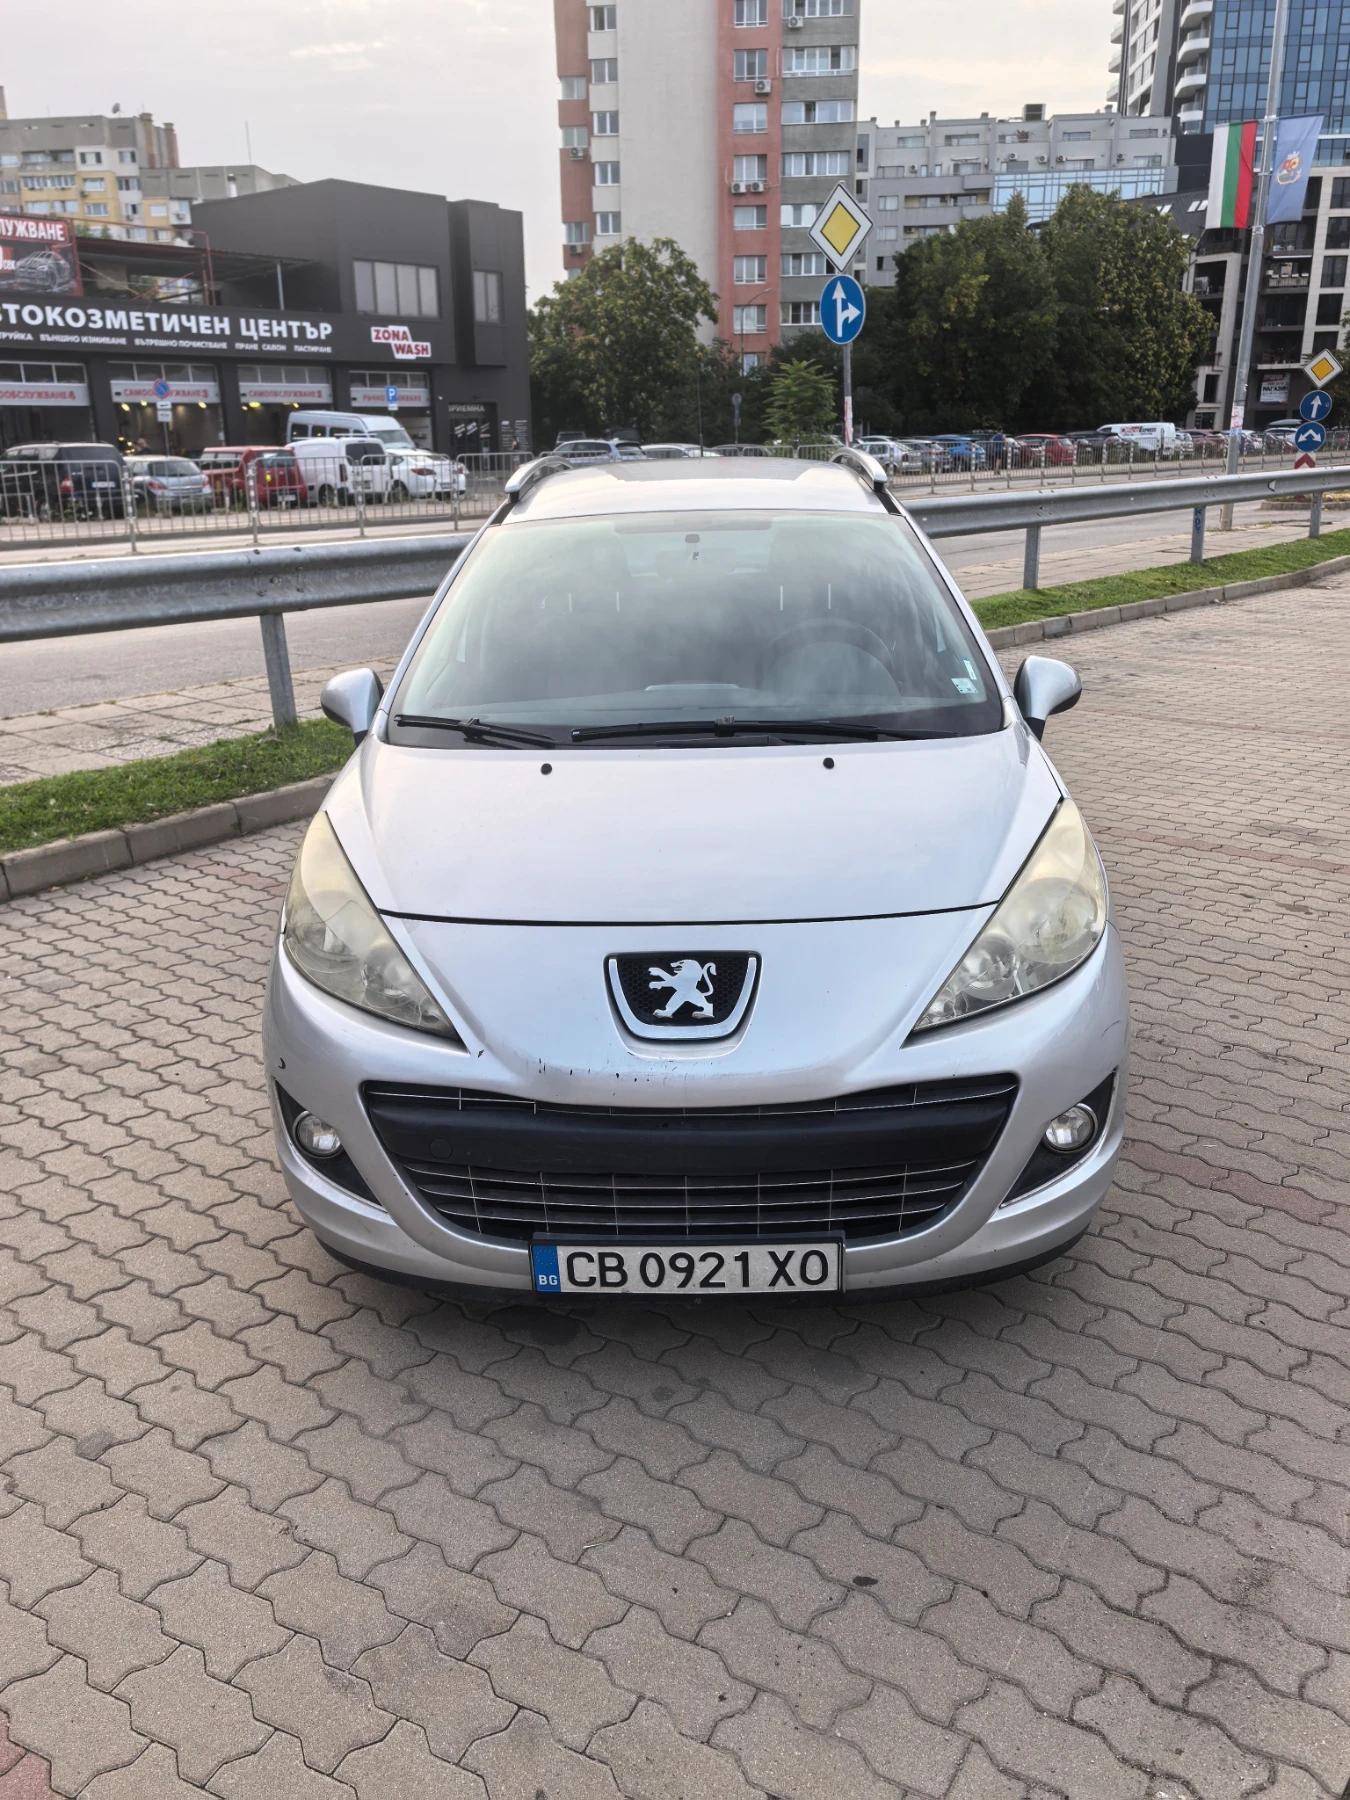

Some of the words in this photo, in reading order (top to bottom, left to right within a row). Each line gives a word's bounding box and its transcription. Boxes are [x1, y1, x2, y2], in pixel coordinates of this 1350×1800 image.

[0, 303, 231, 335] ТОКОЗМЕТИЧЕН
[239, 317, 333, 341] ЦЕНТЪР
[374, 329, 410, 342] ZONA
[39, 333, 80, 344] ВЪНШНО
[134, 338, 178, 347] ВЪТРЕШНО
[178, 340, 228, 350] ПОЧИСТВАНЕ
[235, 342, 259, 351] ПРАНЕ
[261, 343, 287, 352] САЛОН
[393, 343, 430, 356] WASH
[388, 388, 396, 400] P
[566, 1251, 628, 1288] CB
[639, 1251, 750, 1288] 0921
[767, 1250, 830, 1287] XO
[538, 1274, 558, 1287] BG
